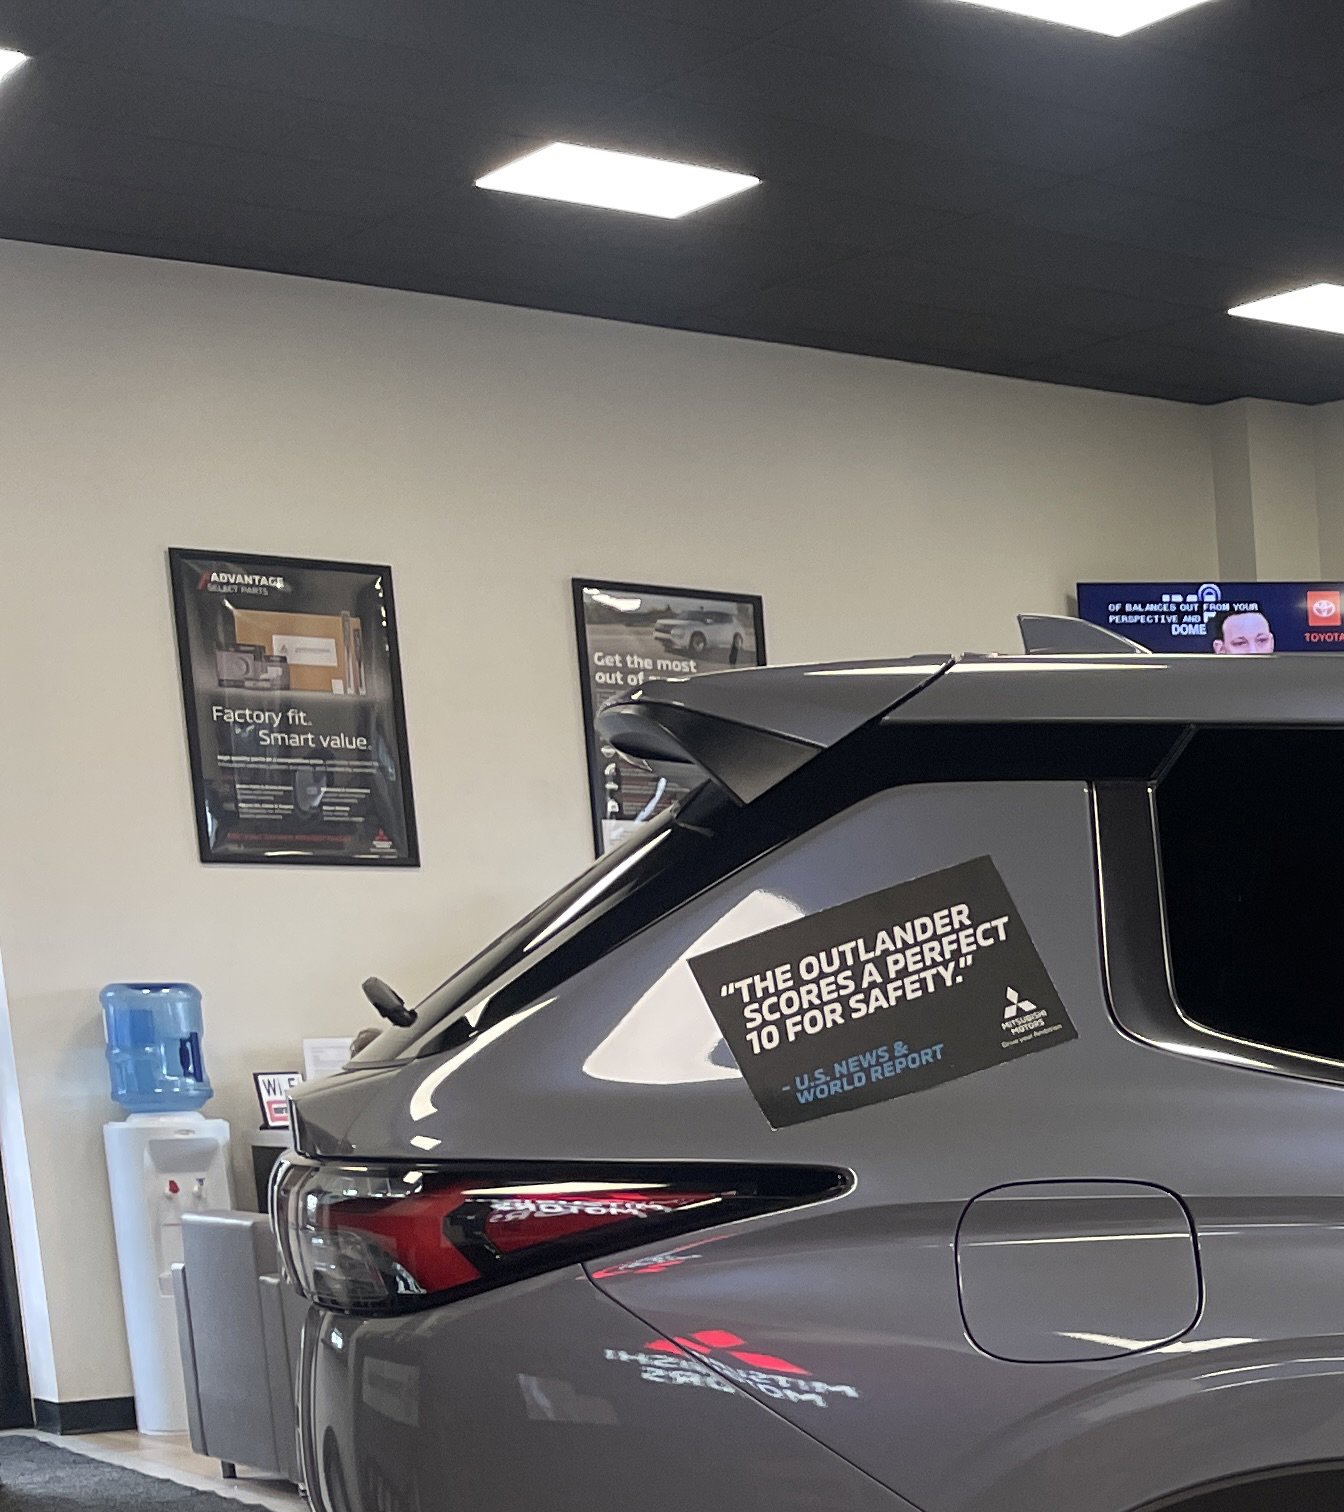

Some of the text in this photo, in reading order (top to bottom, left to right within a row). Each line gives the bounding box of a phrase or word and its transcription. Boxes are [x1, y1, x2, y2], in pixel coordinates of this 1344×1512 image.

[211, 572, 284, 589] ADVANTAGE
[1108, 603, 1258, 612] OF BALANCES OUT FROM YOUR
[1108, 614, 1178, 623] PERSPECTIVE
[1183, 614, 1200, 623] AND
[1171, 623, 1207, 635] DOME
[594, 652, 697, 673] Get the most
[595, 671, 645, 686] out of
[212, 706, 312, 728] Factory fit.
[258, 730, 373, 750] Smart value.
[798, 903, 971, 978] OUTLANDER
[743, 916, 1009, 1029] SCORES A PERFECT
[745, 1025, 780, 1055] 10
[785, 1004, 845, 1043] FOR
[1001, 1009, 1048, 1031] MITSUBISHI
[1010, 1018, 1045, 1035] MOTORS
[795, 1067, 831, 1089] U.S.
[834, 1045, 889, 1078] NEWS
[893, 1040, 910, 1057] &
[796, 1043, 944, 1105] WORLD REPORT
